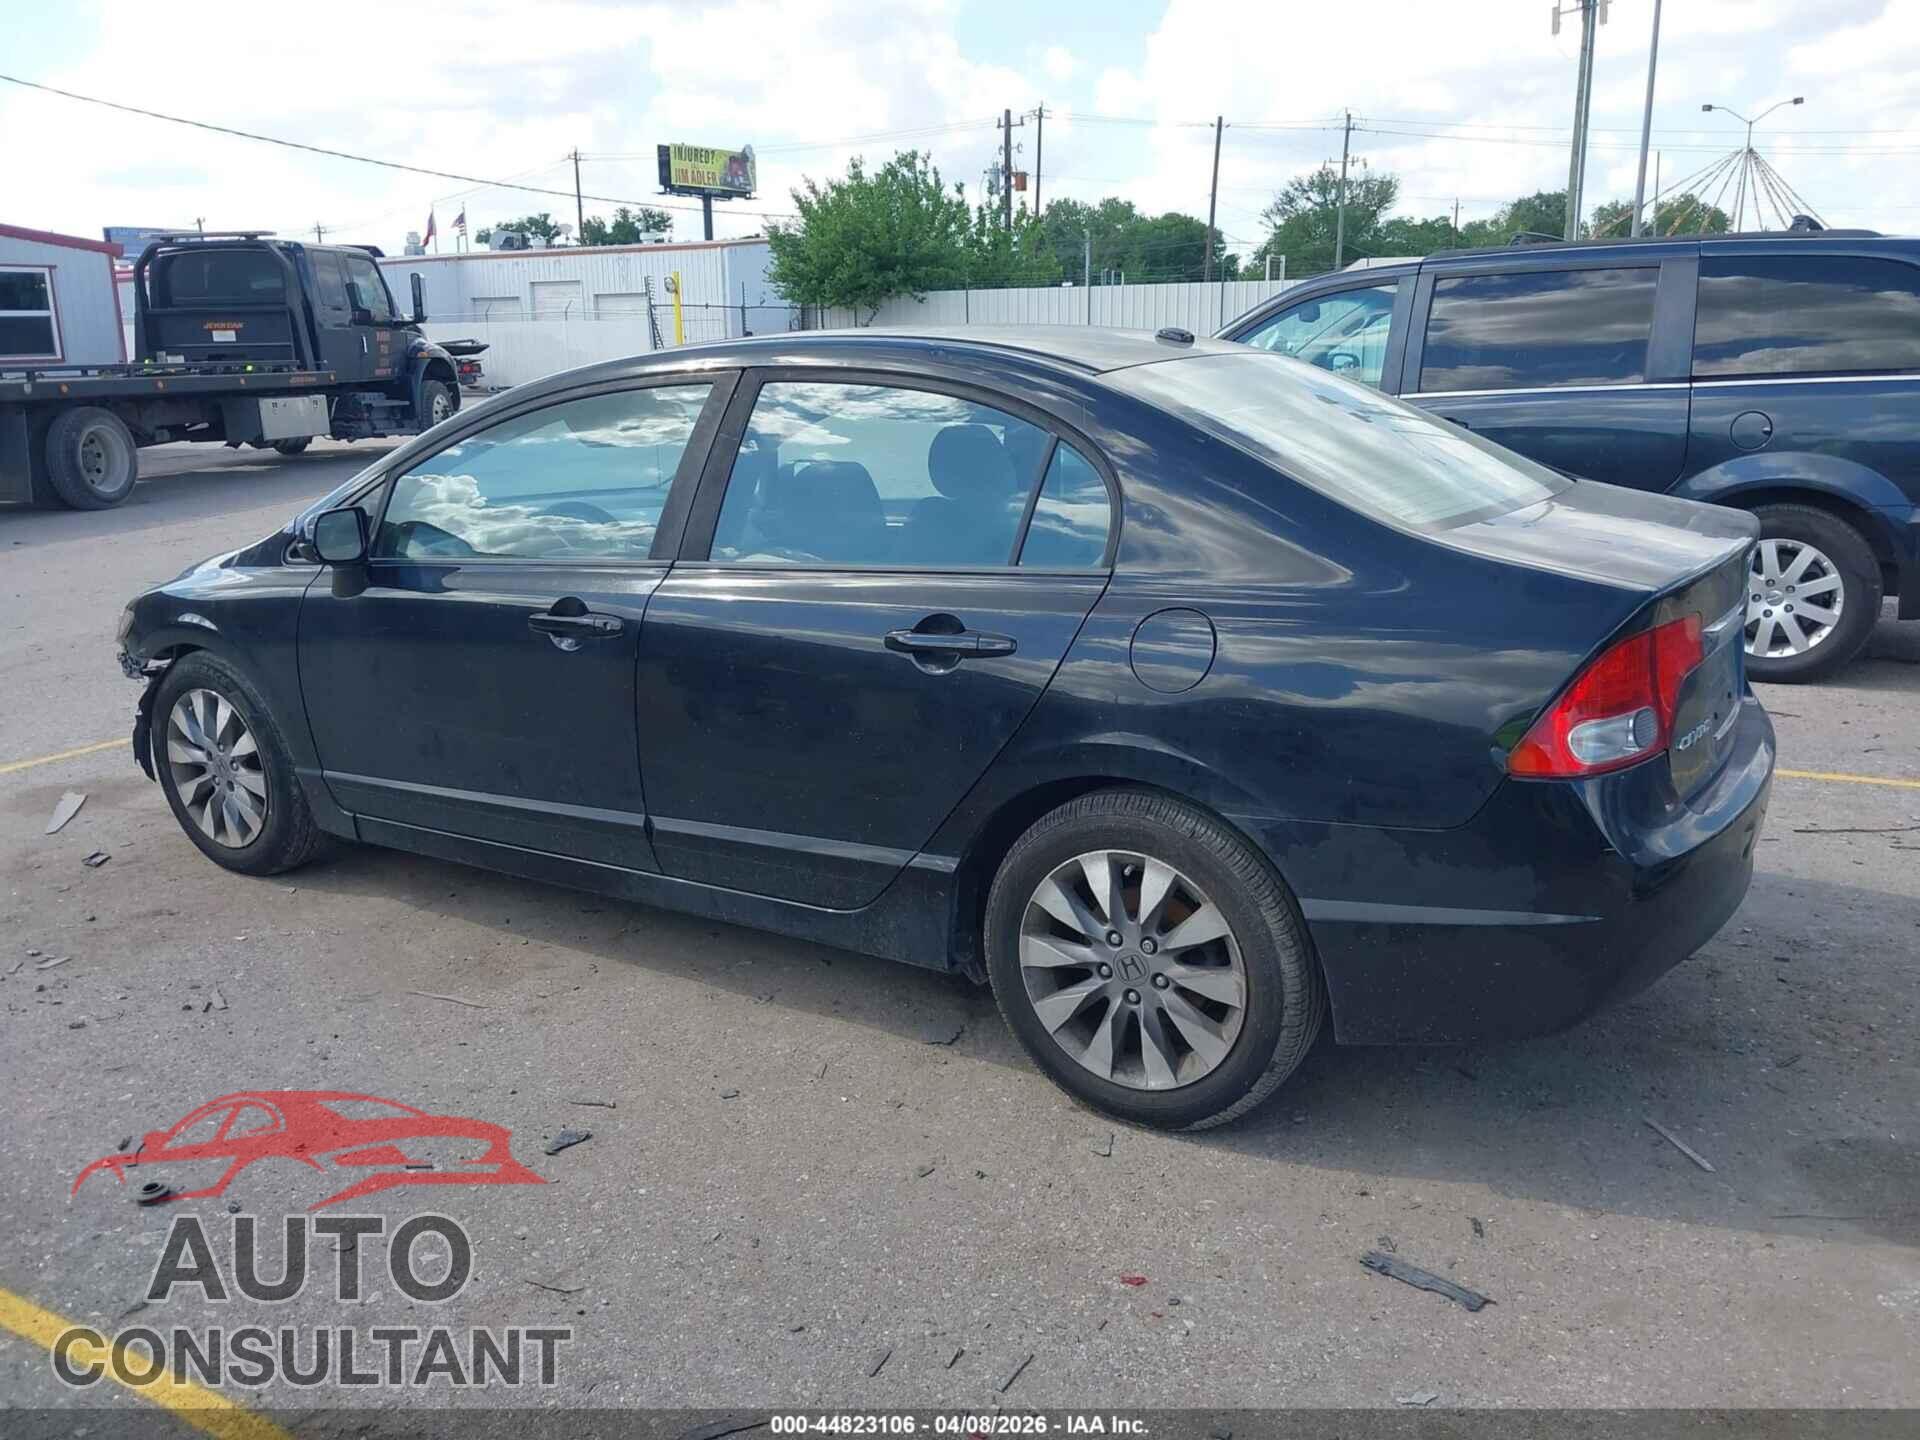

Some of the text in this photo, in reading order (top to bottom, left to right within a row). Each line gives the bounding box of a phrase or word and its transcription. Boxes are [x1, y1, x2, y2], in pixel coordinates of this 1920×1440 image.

[673, 145, 715, 165] INJURED?
[674, 167, 720, 187] JIM ADLER
